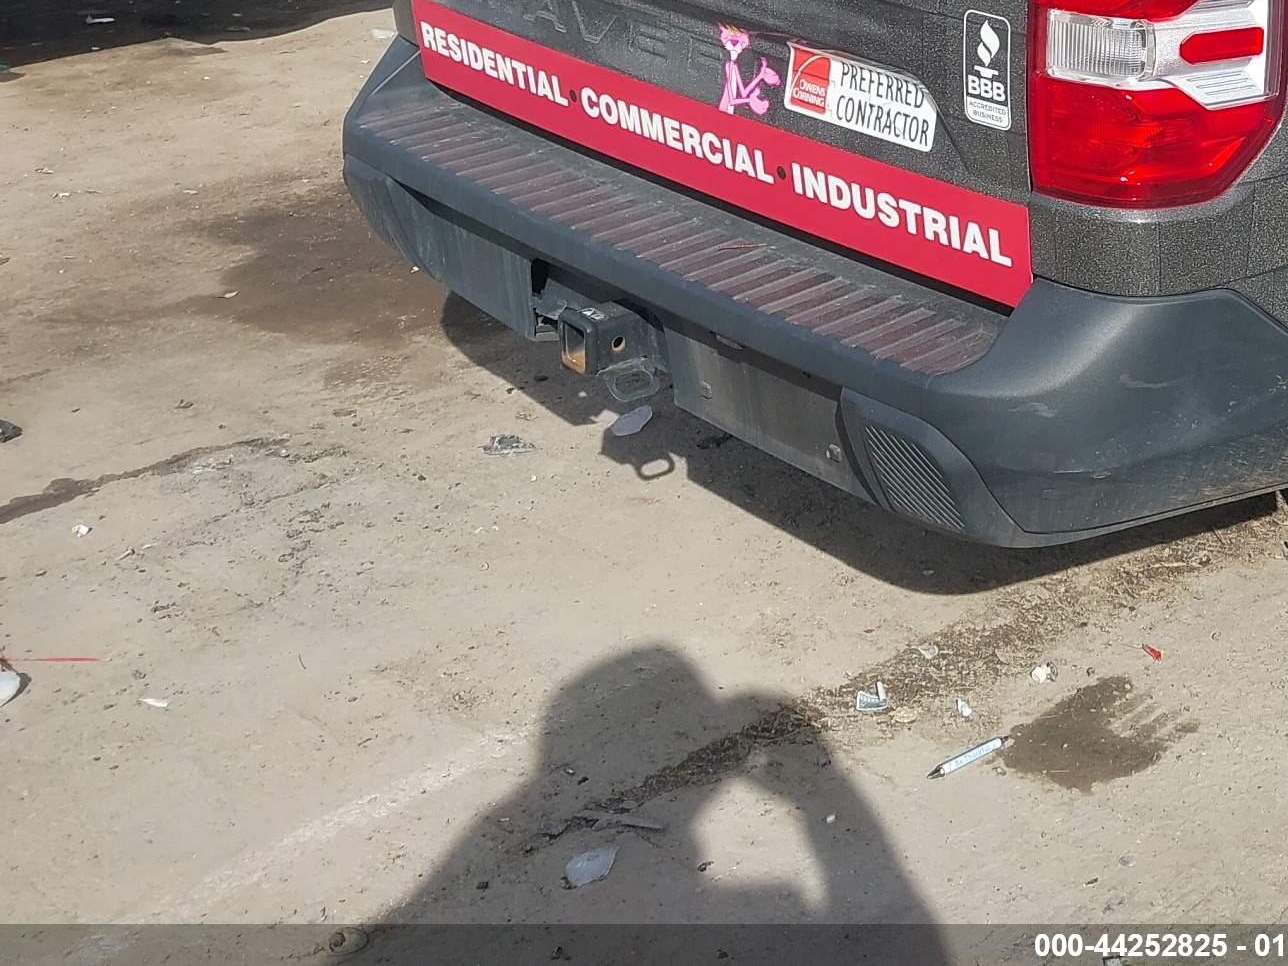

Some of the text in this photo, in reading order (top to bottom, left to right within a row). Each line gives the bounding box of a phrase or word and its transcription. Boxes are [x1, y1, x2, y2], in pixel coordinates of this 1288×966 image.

[792, 87, 825, 107] CORNING
[799, 79, 826, 97] OWENS
[840, 61, 925, 109] PREFERRED
[968, 74, 1006, 102] BBB
[836, 95, 929, 146] CONTRACTOR
[421, 22, 1011, 266] RESIDENTIAL COMMERCIAL INDUSTRIAL
